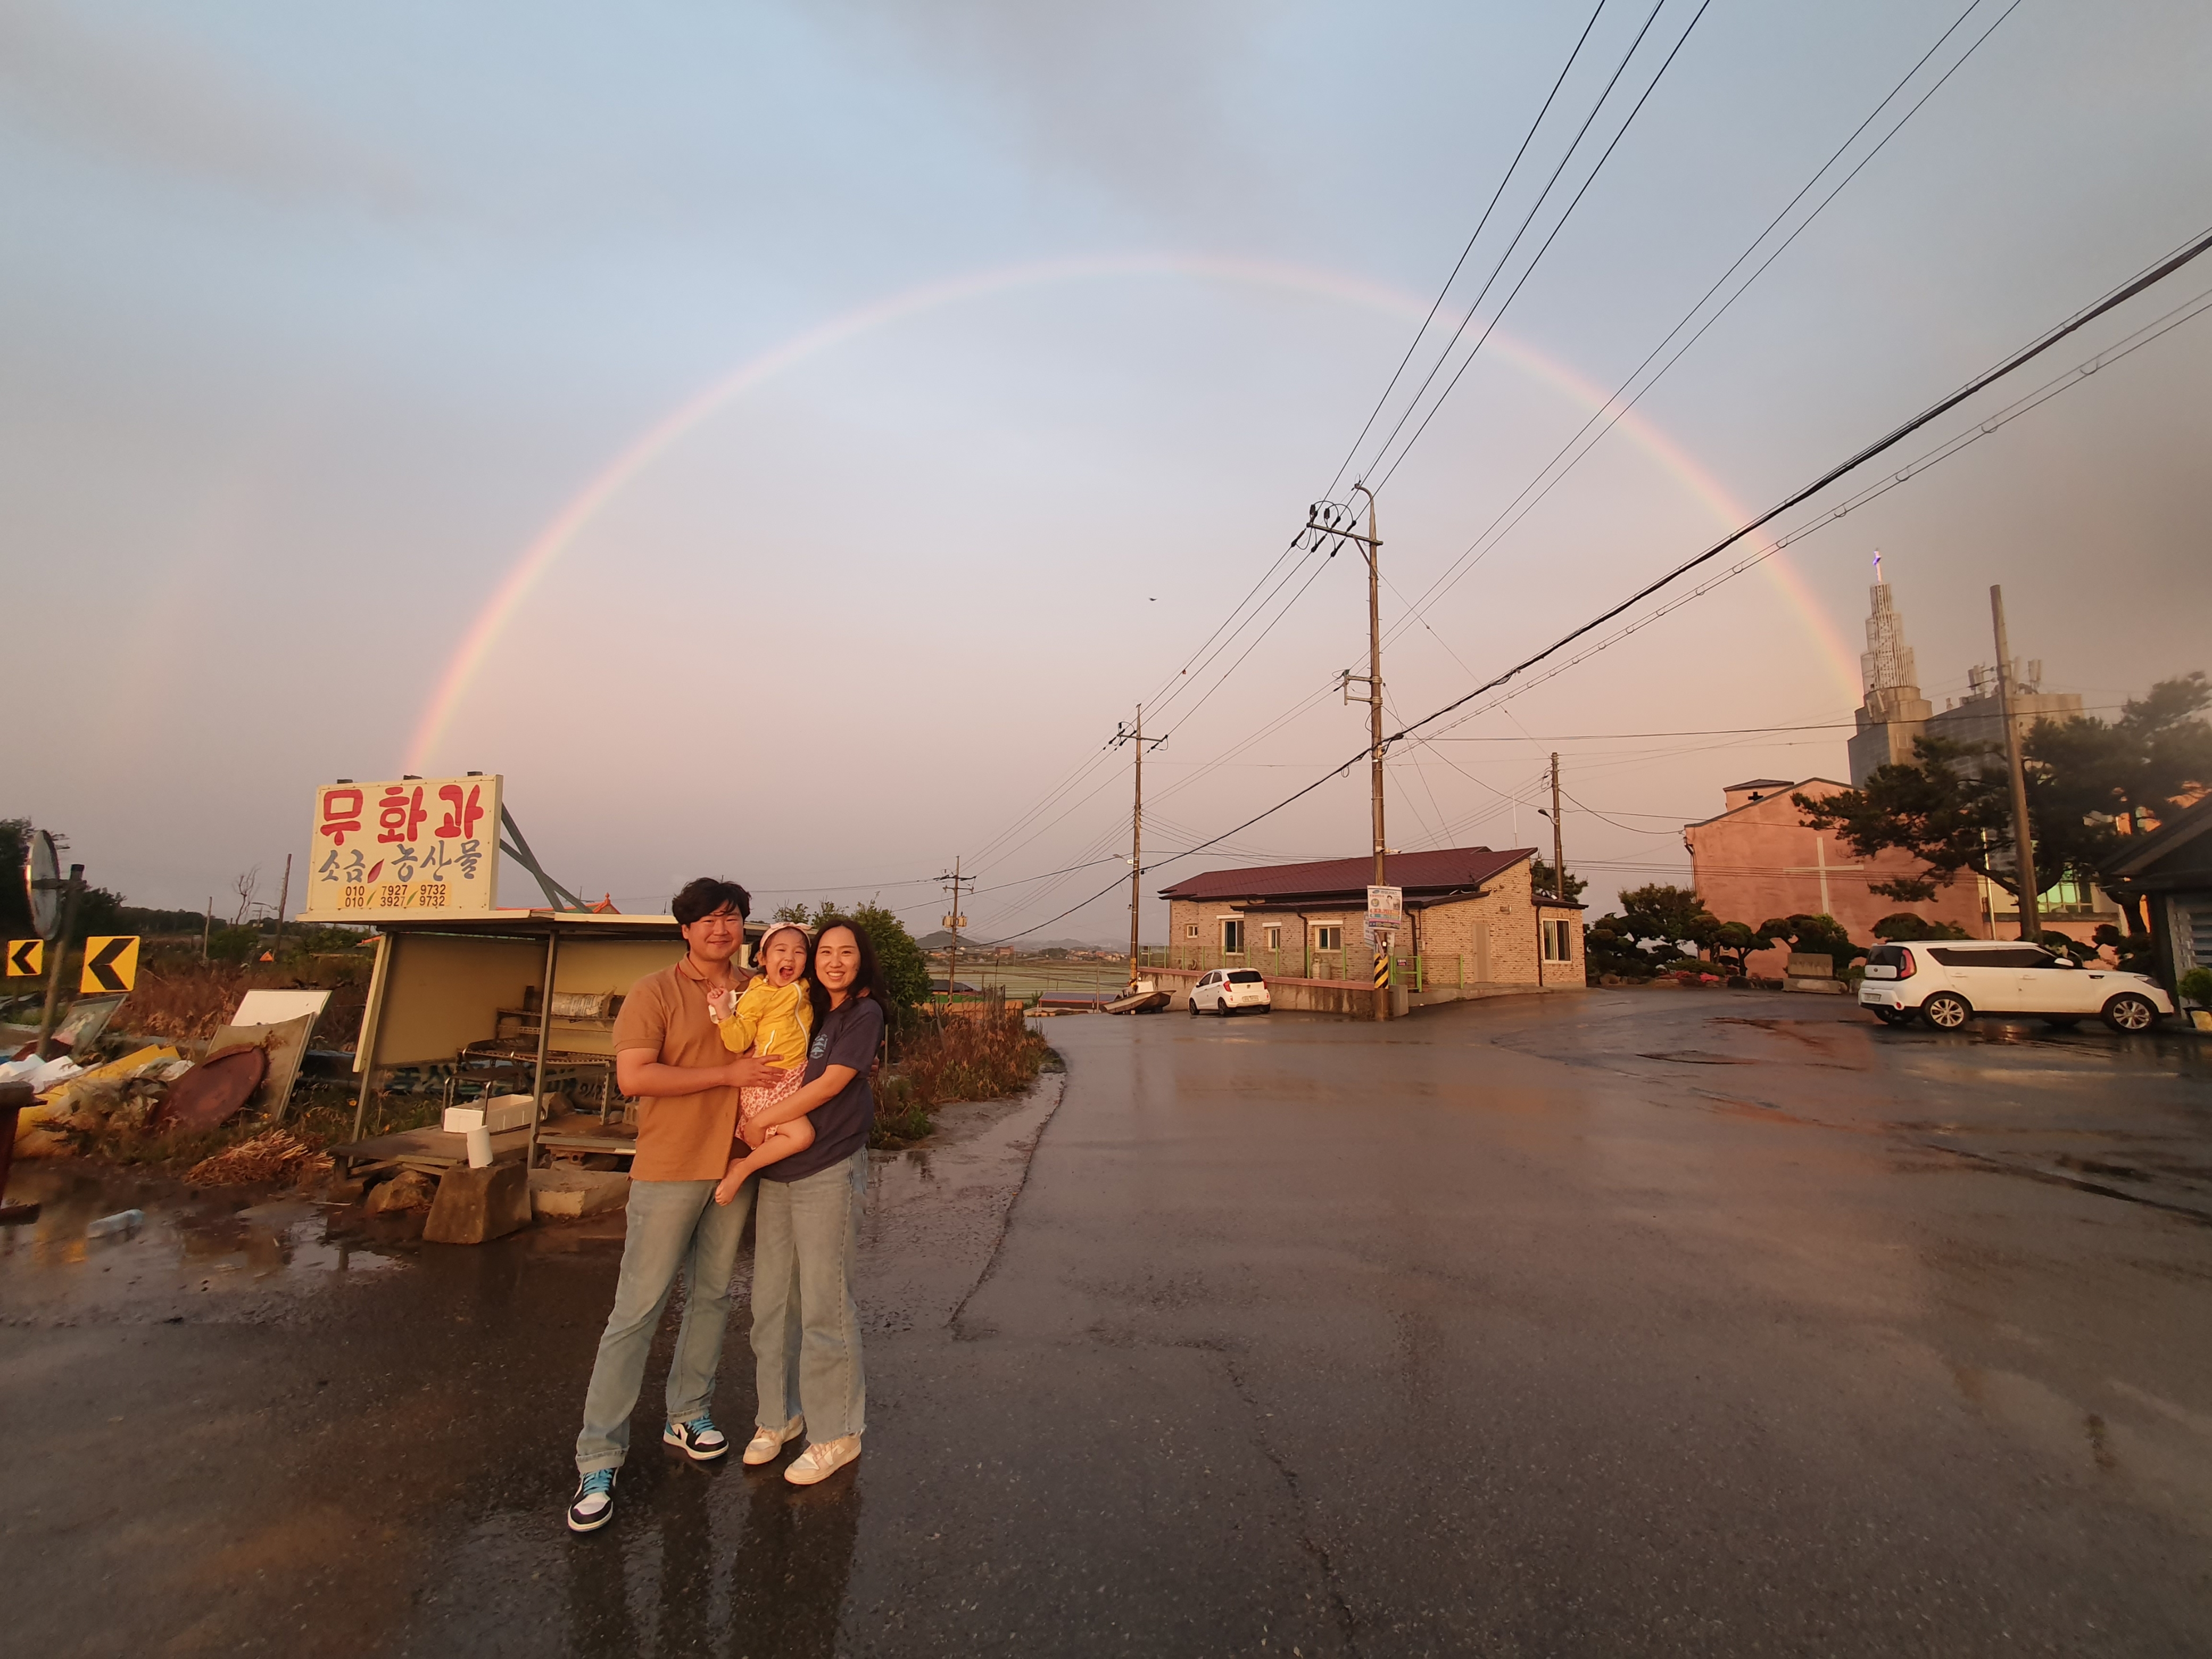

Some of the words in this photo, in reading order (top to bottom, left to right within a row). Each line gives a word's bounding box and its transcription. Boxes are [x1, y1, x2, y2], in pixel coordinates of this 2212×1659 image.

[320, 785, 484, 846] 무화과
[318, 849, 366, 883] 소금
[391, 839, 482, 882] 농산물
[345, 885, 365, 896] 010
[382, 885, 408, 896] 7927
[420, 884, 446, 895] 9732
[345, 896, 364, 907] 010
[380, 896, 406, 907] 3927
[419, 895, 445, 906] 9732
